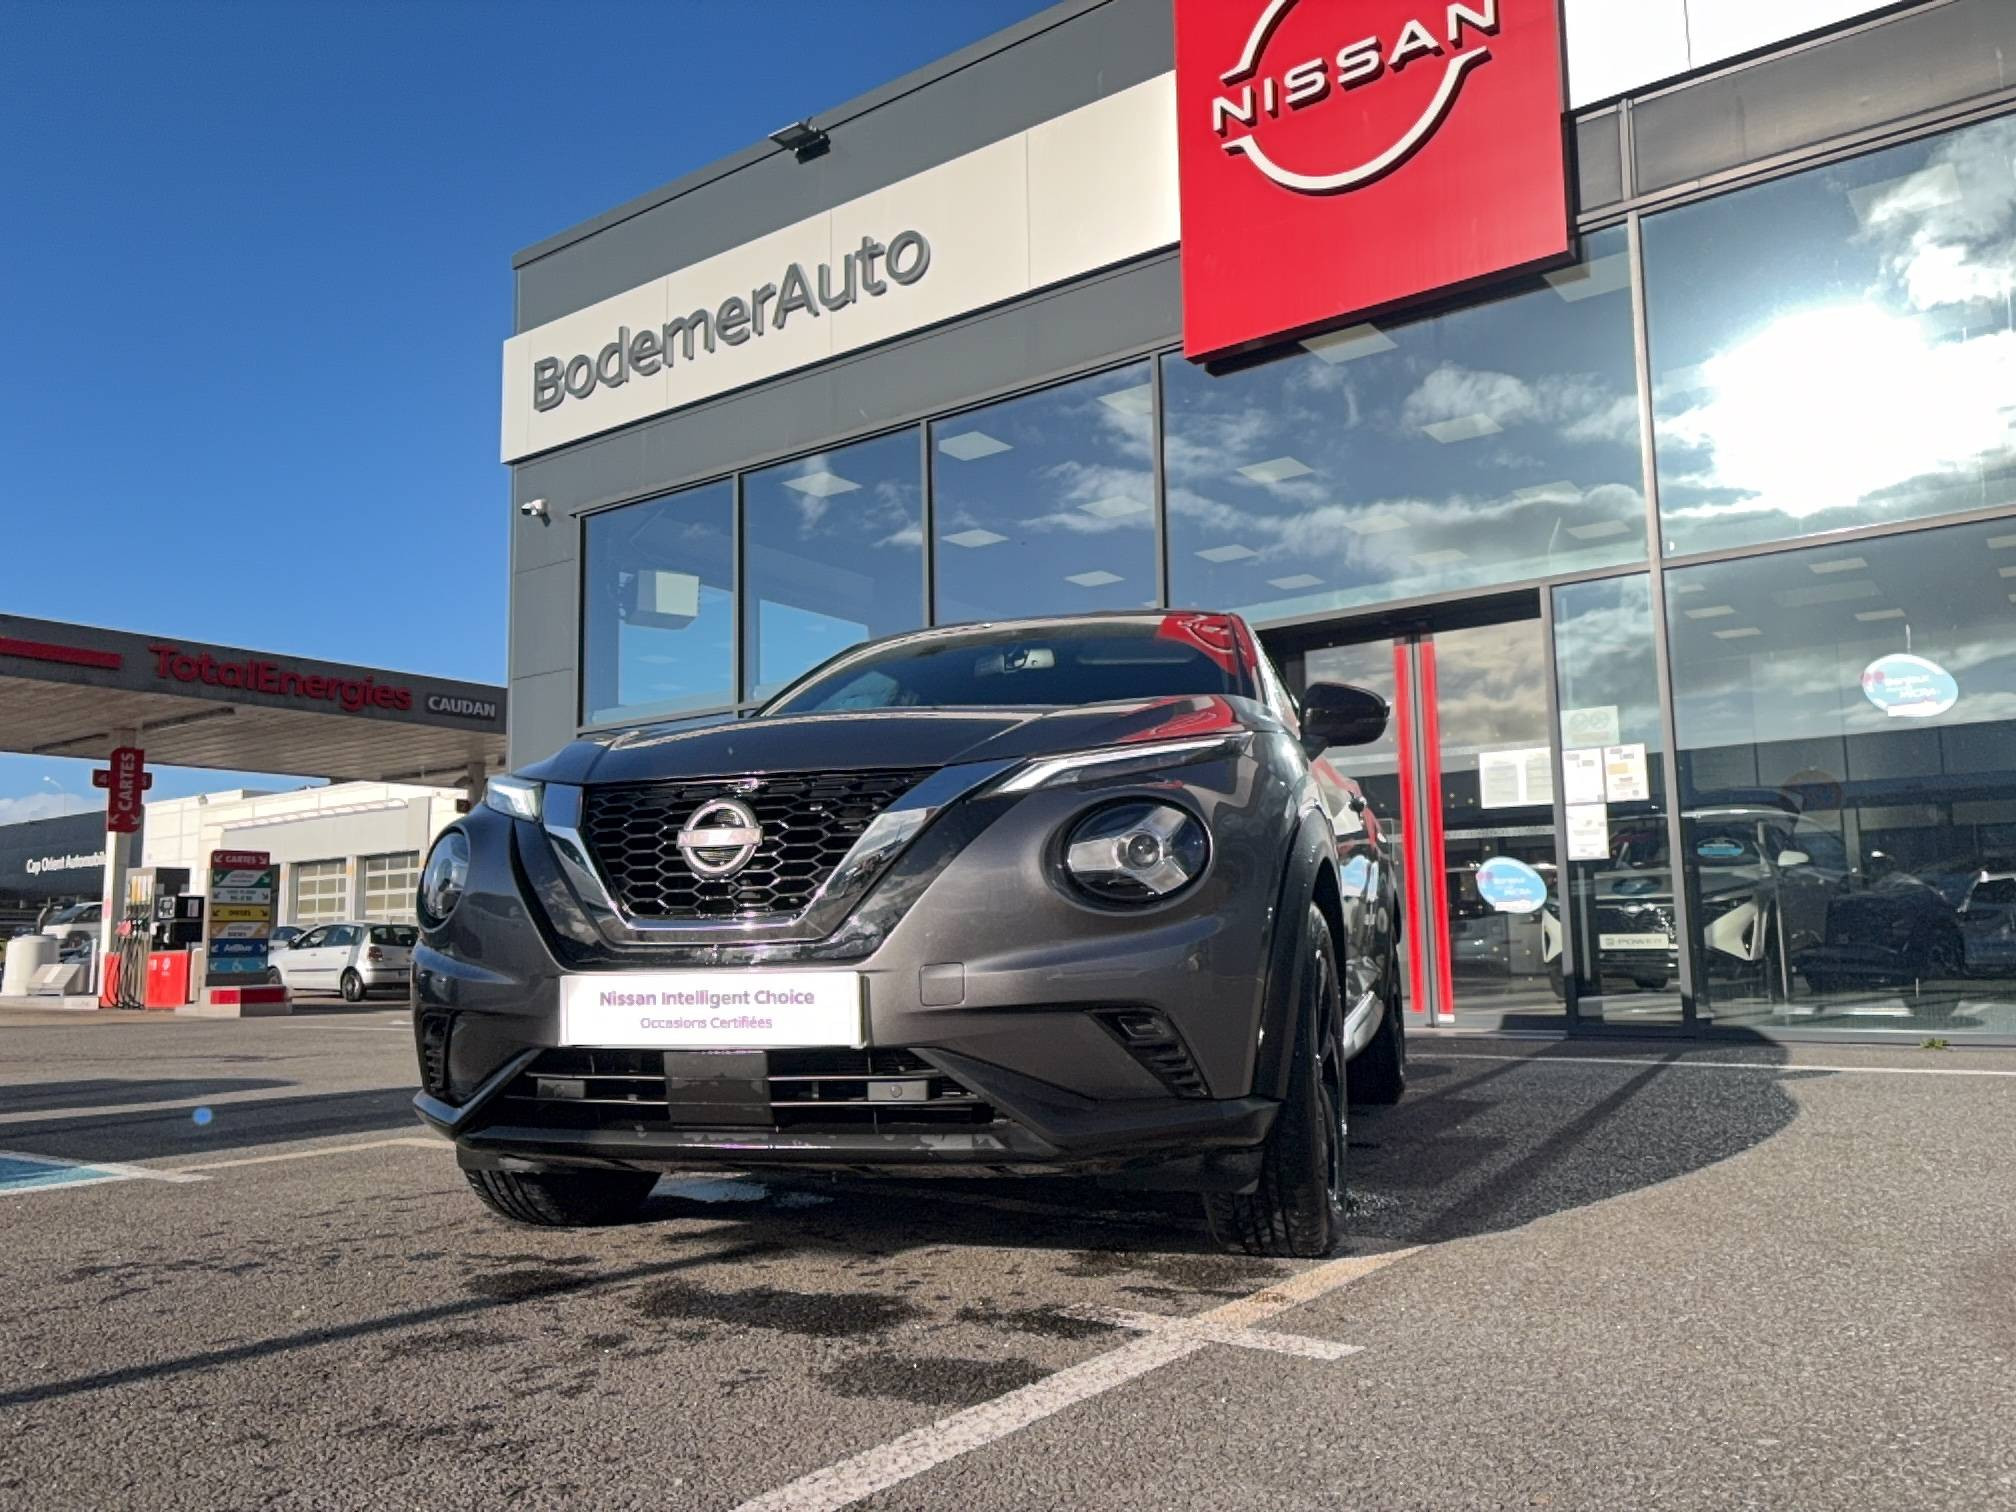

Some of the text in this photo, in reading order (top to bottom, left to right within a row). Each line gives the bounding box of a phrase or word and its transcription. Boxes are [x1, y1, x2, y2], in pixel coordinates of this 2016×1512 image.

[1211, 0, 1498, 136] NISSAN
[533, 229, 931, 413] BodemerAuto
[147, 645, 413, 713] TotalEnergies
[427, 695, 496, 718] CAUDAN
[118, 752, 135, 811] CARTES
[678, 830, 761, 846] NIAN
[599, 988, 816, 1009] Nissan Intelligent Choice
[640, 1015, 773, 1029] Occasions Certifiées
